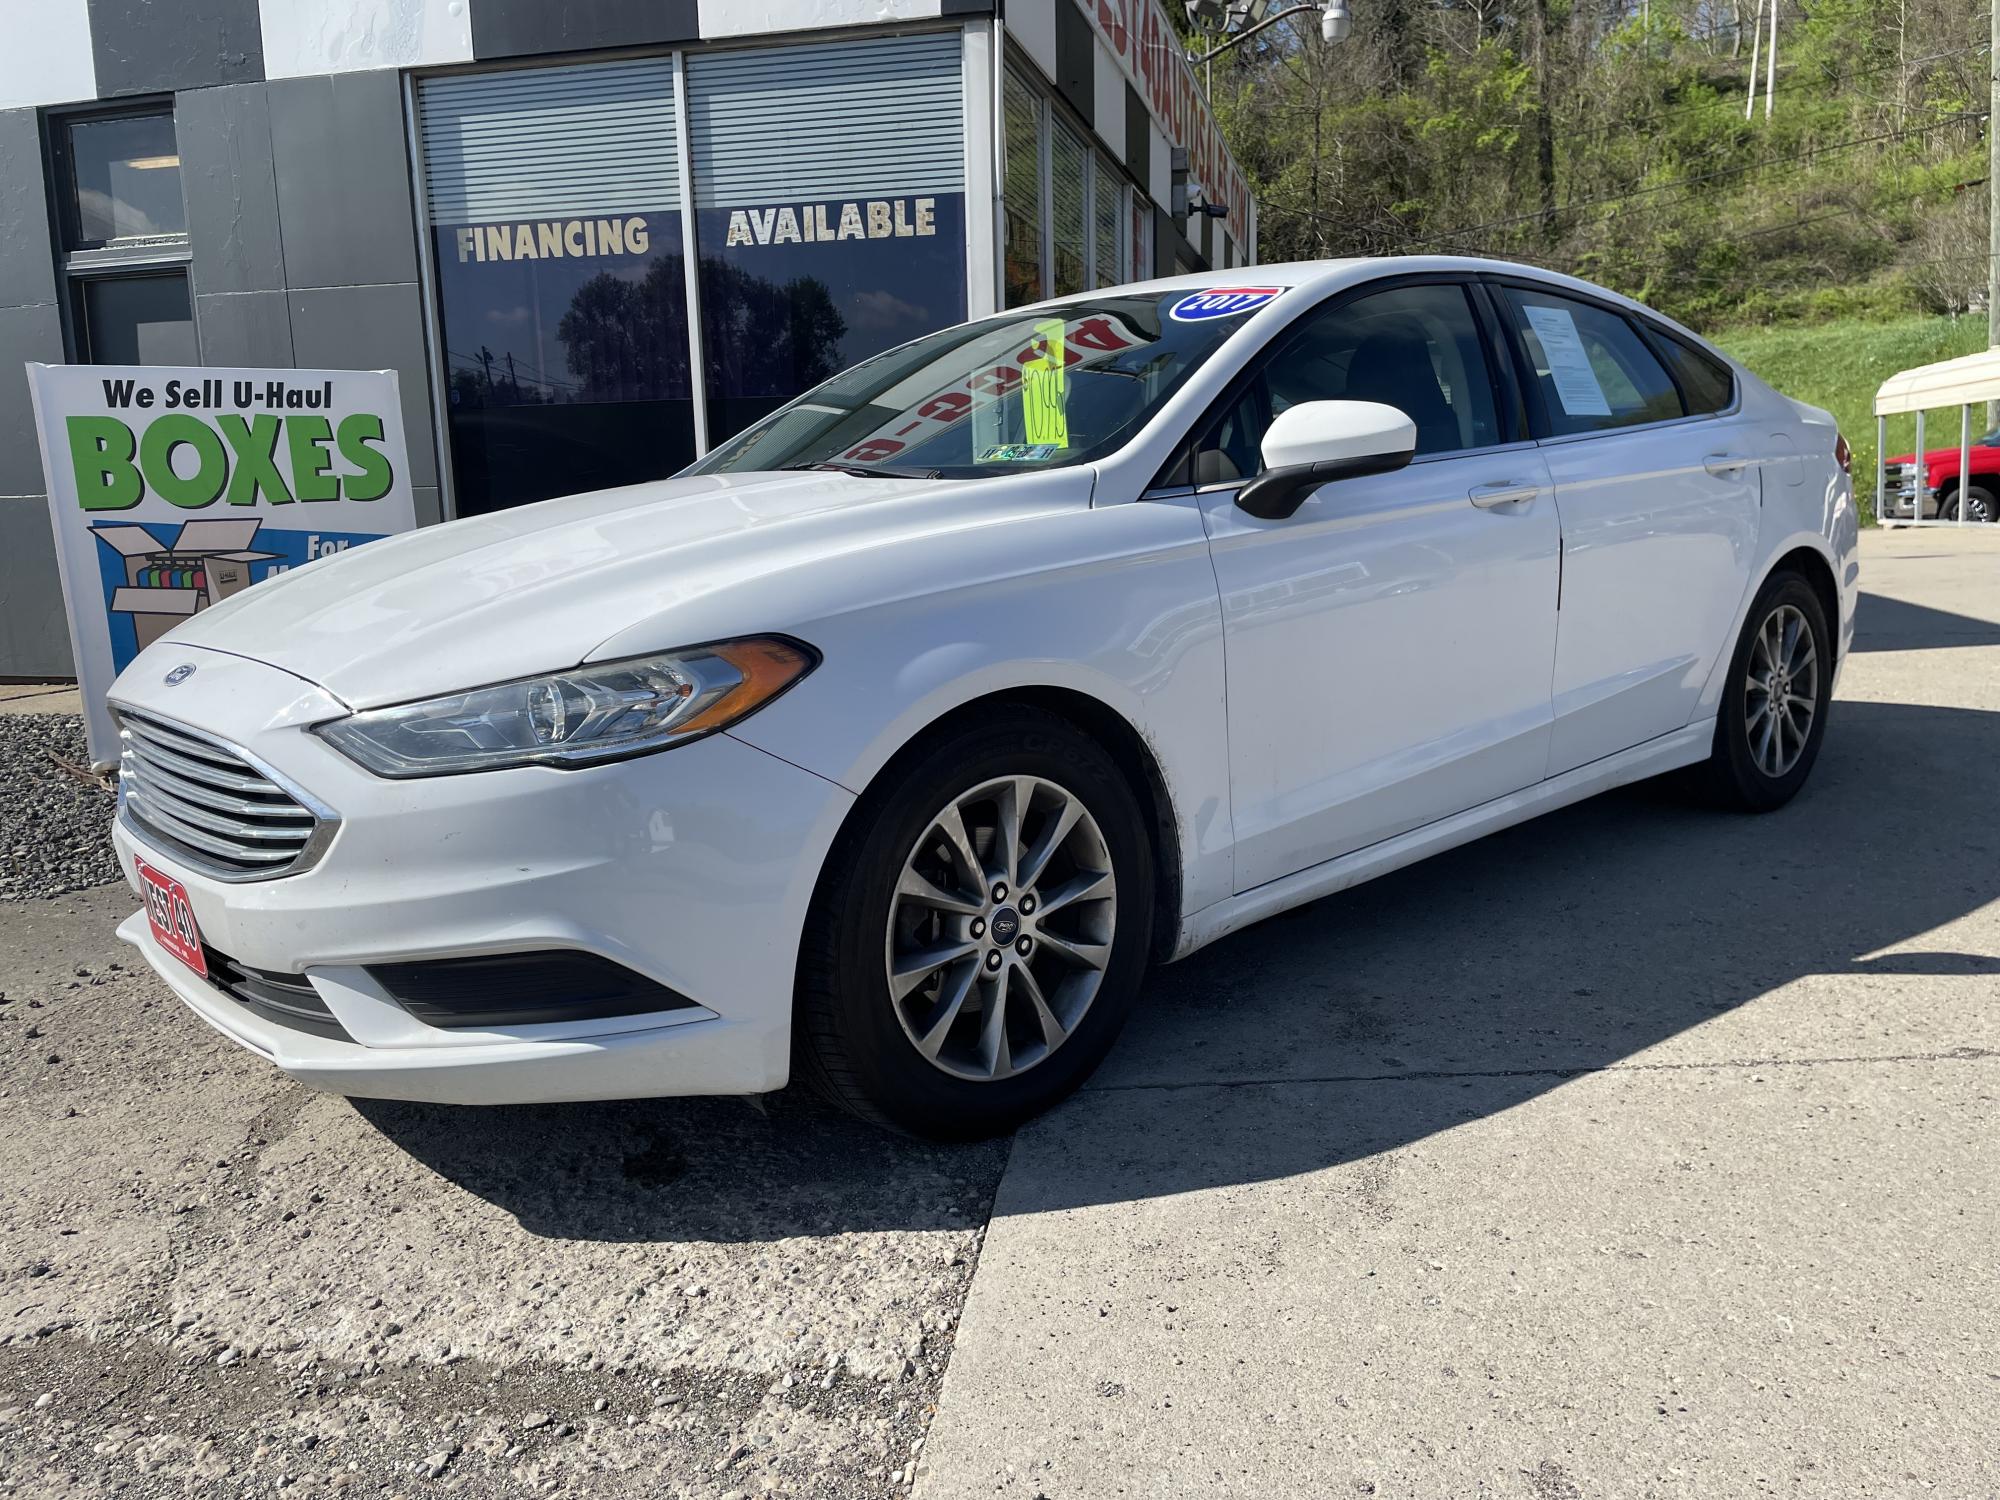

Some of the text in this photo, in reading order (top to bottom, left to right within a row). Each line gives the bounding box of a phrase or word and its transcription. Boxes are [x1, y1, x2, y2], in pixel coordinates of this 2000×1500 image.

[456, 198, 936, 263] FINANCING AVAILABLE
[1179, 294, 1264, 311] 2017
[102, 379, 332, 409] We Sell U-Haul
[66, 413, 394, 512] BOXES
[307, 534, 349, 561] For
[140, 876, 177, 939] WEST
[173, 893, 198, 953] 40
